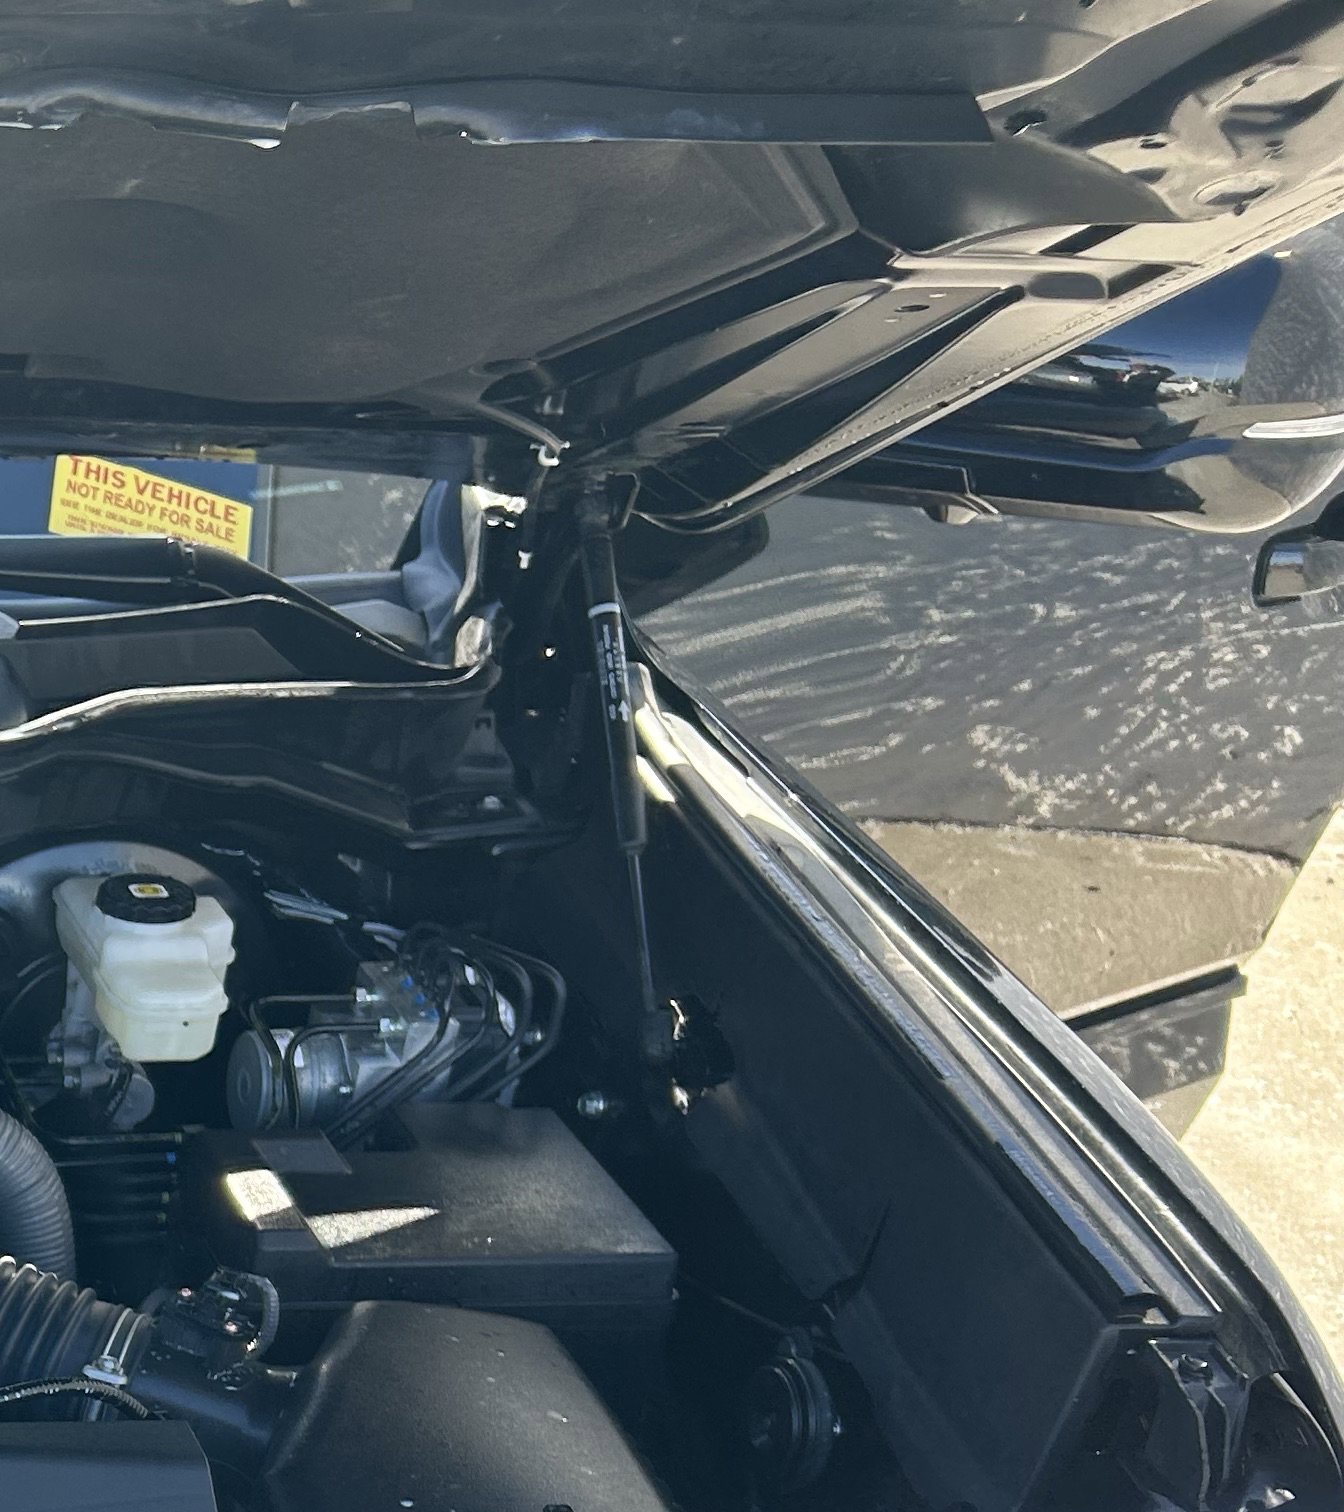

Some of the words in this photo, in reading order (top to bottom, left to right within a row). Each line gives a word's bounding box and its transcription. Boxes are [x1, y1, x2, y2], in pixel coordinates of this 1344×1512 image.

[65, 479, 100, 504] NOT
[103, 489, 157, 518] READY
[159, 507, 192, 531] FOR
[194, 518, 236, 543] SALE
[68, 456, 126, 490] THIS
[133, 474, 239, 526] VEHICLE
